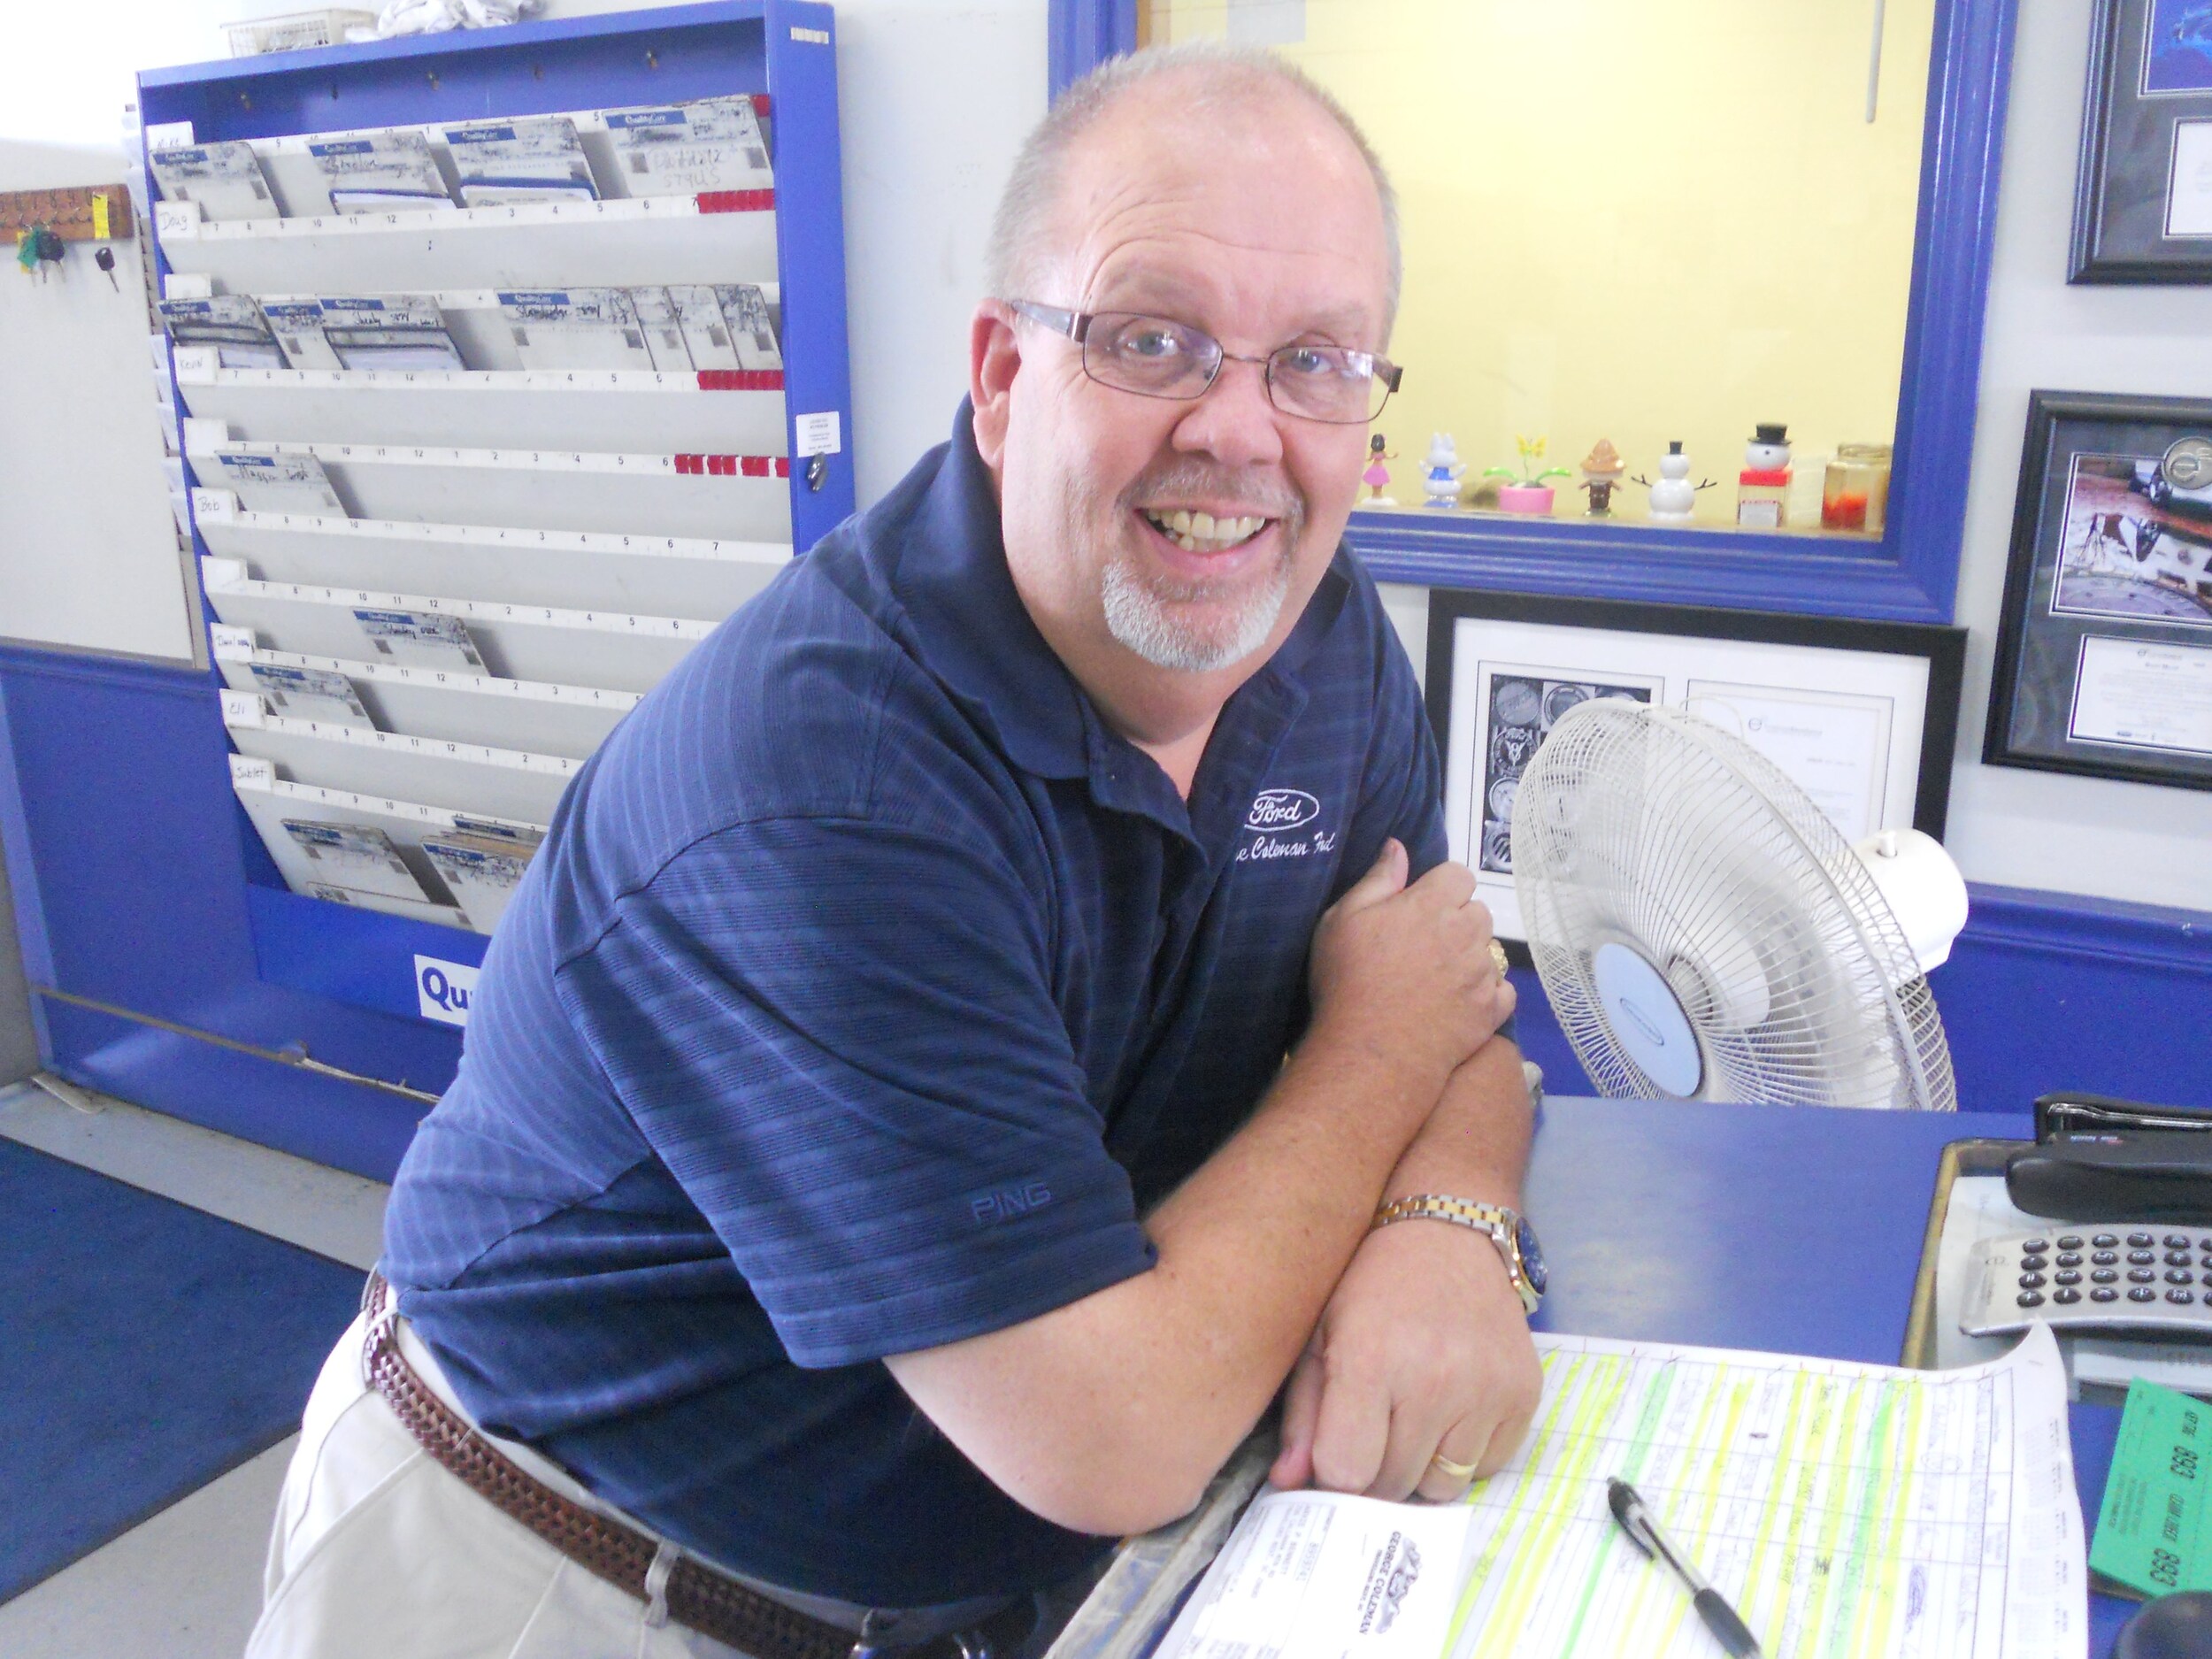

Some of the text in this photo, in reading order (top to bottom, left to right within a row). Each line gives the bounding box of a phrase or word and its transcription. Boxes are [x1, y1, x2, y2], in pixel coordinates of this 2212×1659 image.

[1248, 795, 1302, 825] Ford
[1250, 836, 1309, 860] Coleman
[422, 966, 472, 1011] Qu
[971, 1182, 1053, 1225] PING
[2170, 1445, 2200, 1479] 893
[1359, 1531, 1402, 1635] GEORGE COLEMAN
[2149, 1548, 2181, 1587] 893
